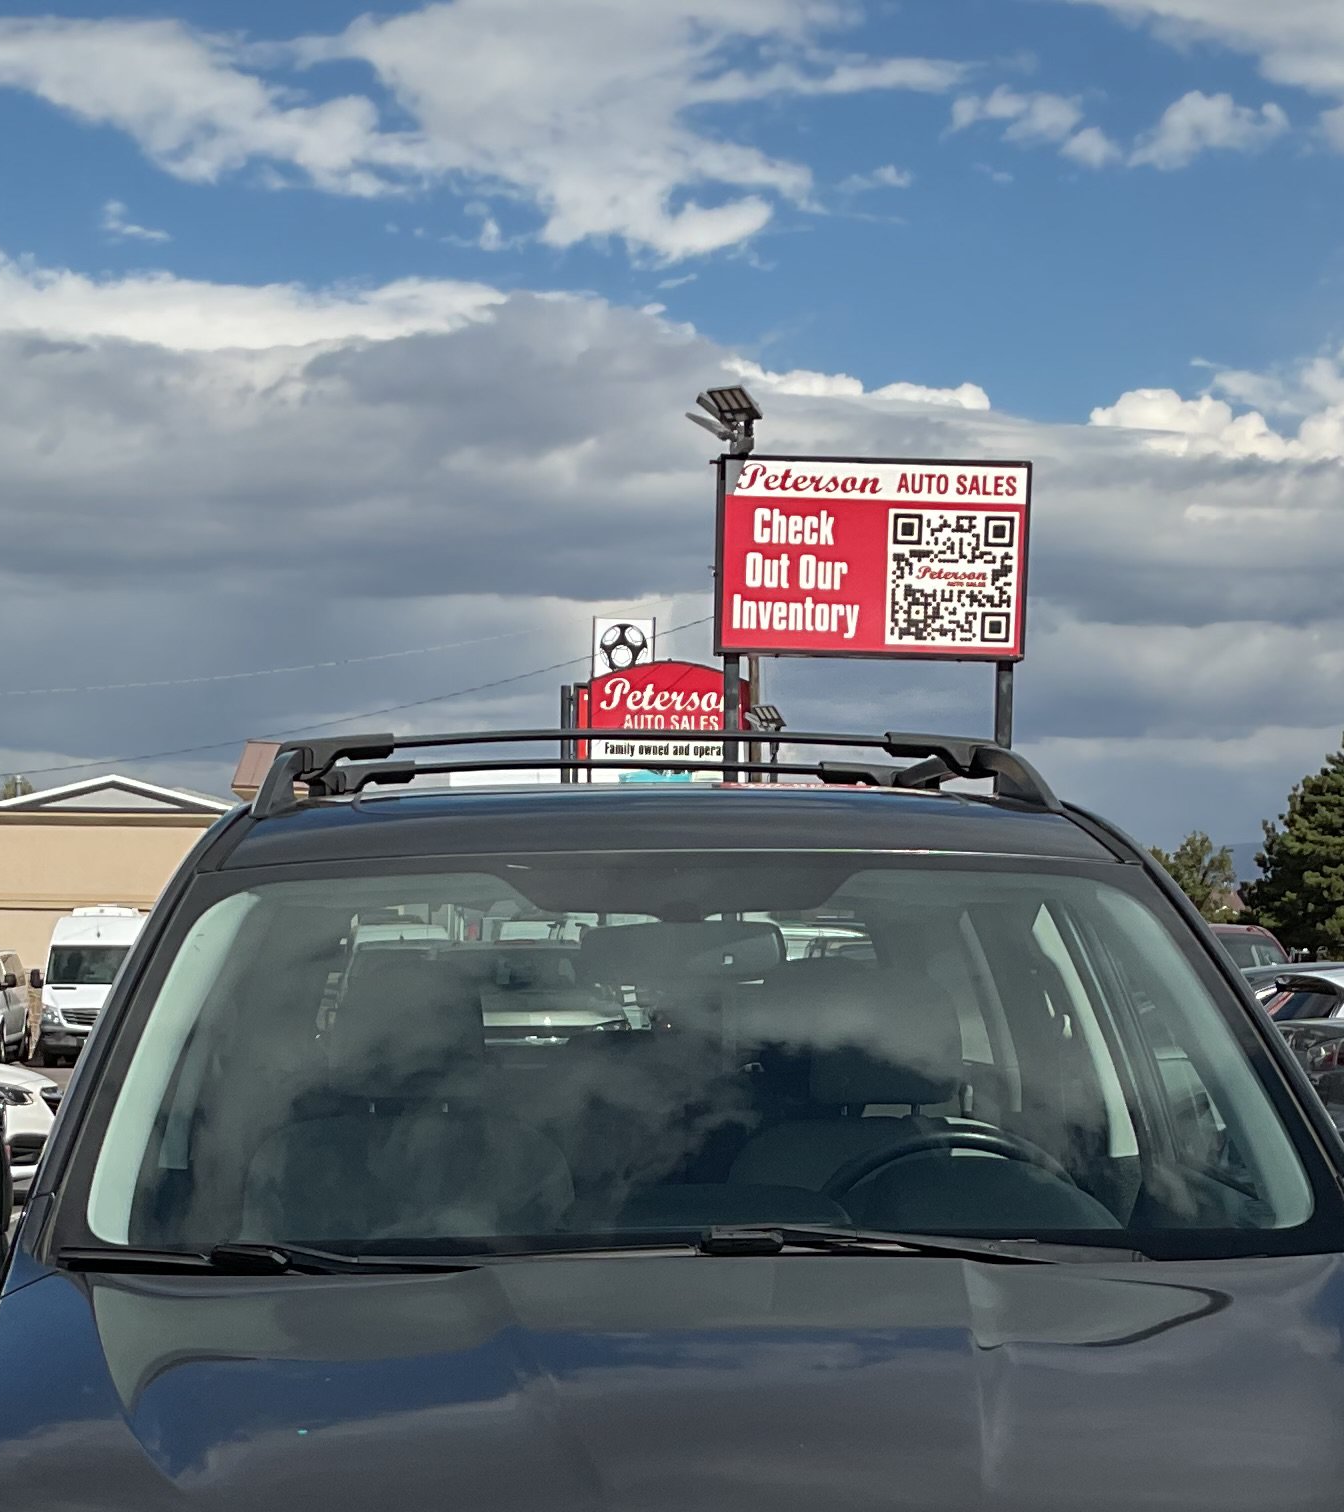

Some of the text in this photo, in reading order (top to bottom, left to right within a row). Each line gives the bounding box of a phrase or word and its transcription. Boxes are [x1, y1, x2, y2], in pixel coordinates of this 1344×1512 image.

[737, 463, 1017, 497] Peterson AUTO SALES
[753, 507, 835, 546] Check
[745, 551, 849, 591] Out Our
[916, 565, 988, 581] Peterson
[732, 593, 860, 639] Inventory
[623, 713, 665, 730] AUTO
[604, 741, 635, 757] Family
[638, 742, 669, 756] owned
[672, 742, 690, 756] and
